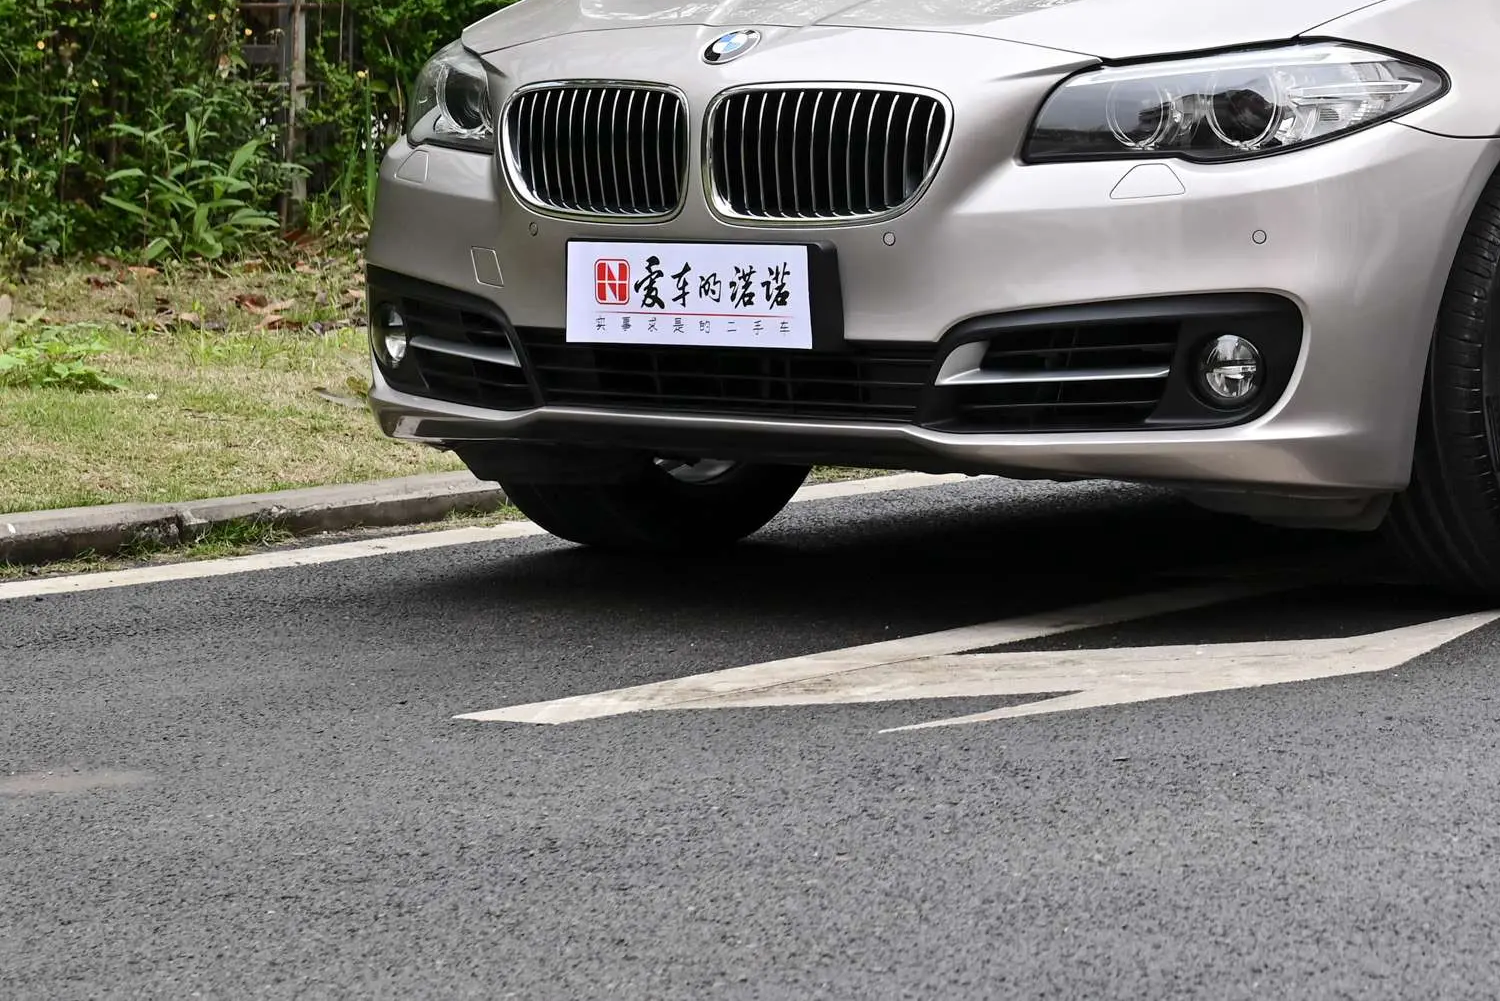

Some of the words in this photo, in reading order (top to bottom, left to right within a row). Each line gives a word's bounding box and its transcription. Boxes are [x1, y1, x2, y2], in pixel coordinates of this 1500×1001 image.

[594, 315, 792, 336] 实事求是的二手车
